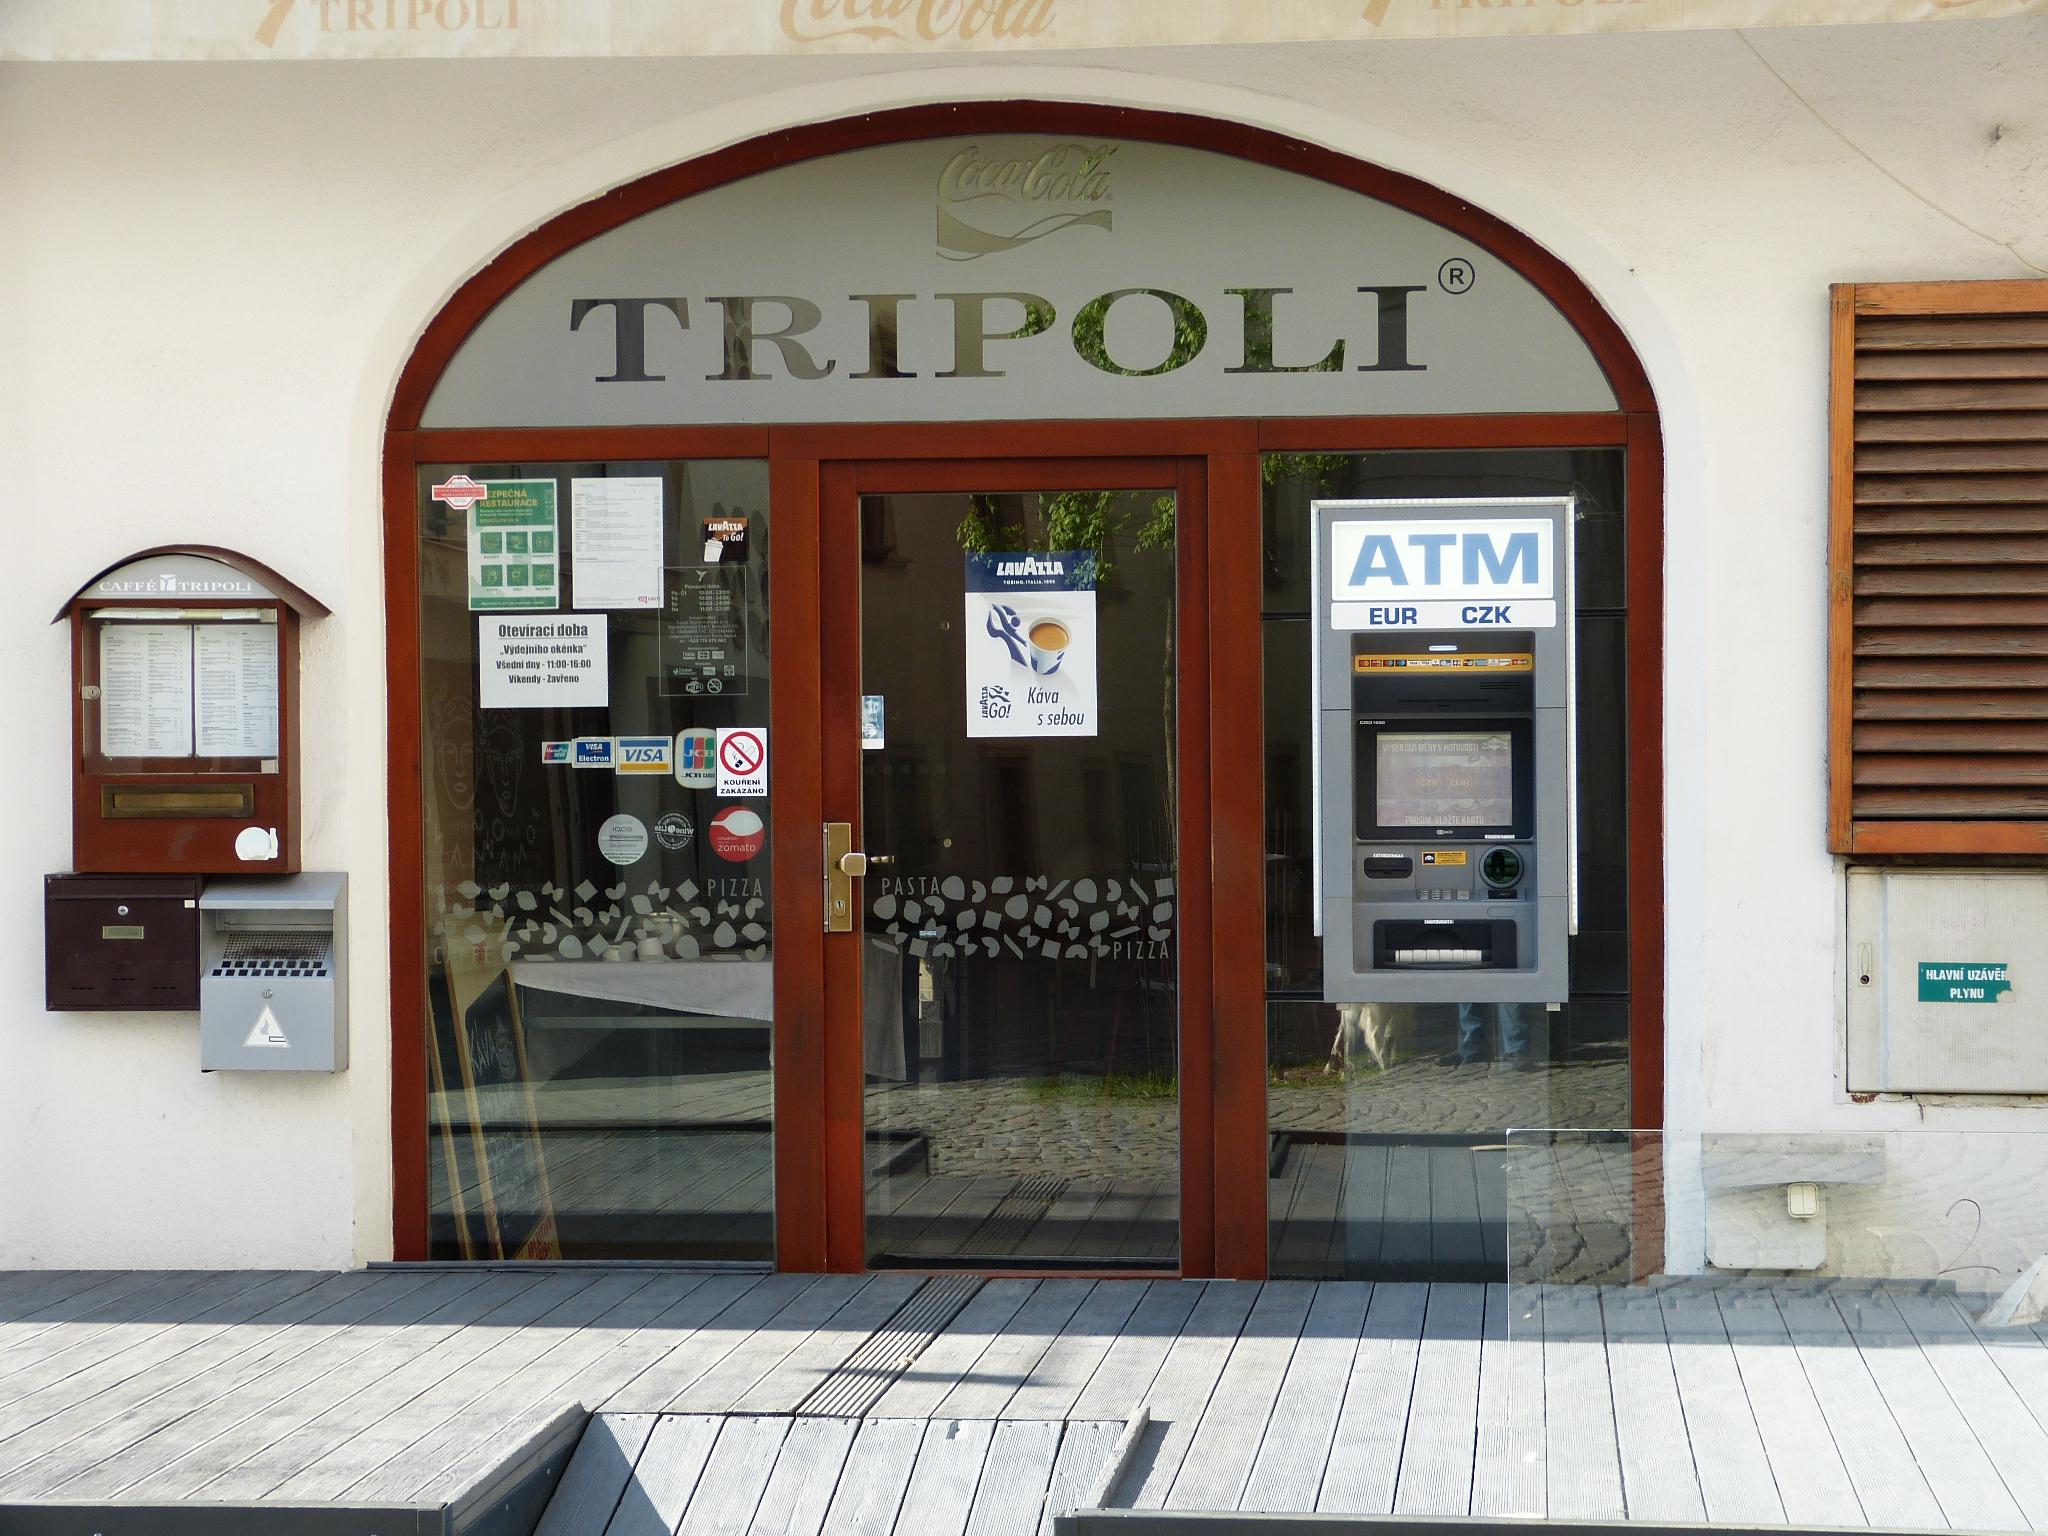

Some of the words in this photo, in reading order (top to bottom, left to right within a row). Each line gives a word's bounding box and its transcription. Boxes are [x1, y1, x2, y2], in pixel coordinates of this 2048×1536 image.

[570, 286, 1428, 383] TRIPOLI
[708, 520, 744, 531] LAVAZZA
[730, 532, 744, 542] Go!
[996, 557, 1065, 576] LAVAZZA
[1348, 532, 1540, 587] ATM
[178, 581, 252, 592] TRIPOLI
[1369, 607, 1418, 625] EUR
[1461, 606, 1512, 624] CZK
[557, 623, 588, 637] doba
[496, 660, 524, 670] Všední
[525, 660, 541, 670] dny
[509, 674, 542, 684] Víkendy
[547, 674, 580, 683] Zavřeno
[1027, 686, 1059, 704] Káva
[988, 702, 1012, 719] Go!
[1037, 713, 1044, 726] s
[1047, 706, 1085, 726] sebou
[585, 743, 604, 751] VISA
[684, 749, 714, 757] JCB
[578, 755, 610, 763] Electron
[624, 749, 664, 762] VISA
[717, 843, 756, 852] zomato
[708, 878, 763, 897] PIZZA
[881, 876, 941, 896] PASTA
[1113, 940, 1169, 960] PIZZA
[1925, 967, 1965, 981] HLAVNÍ
[1949, 987, 1985, 999] PLYNU
